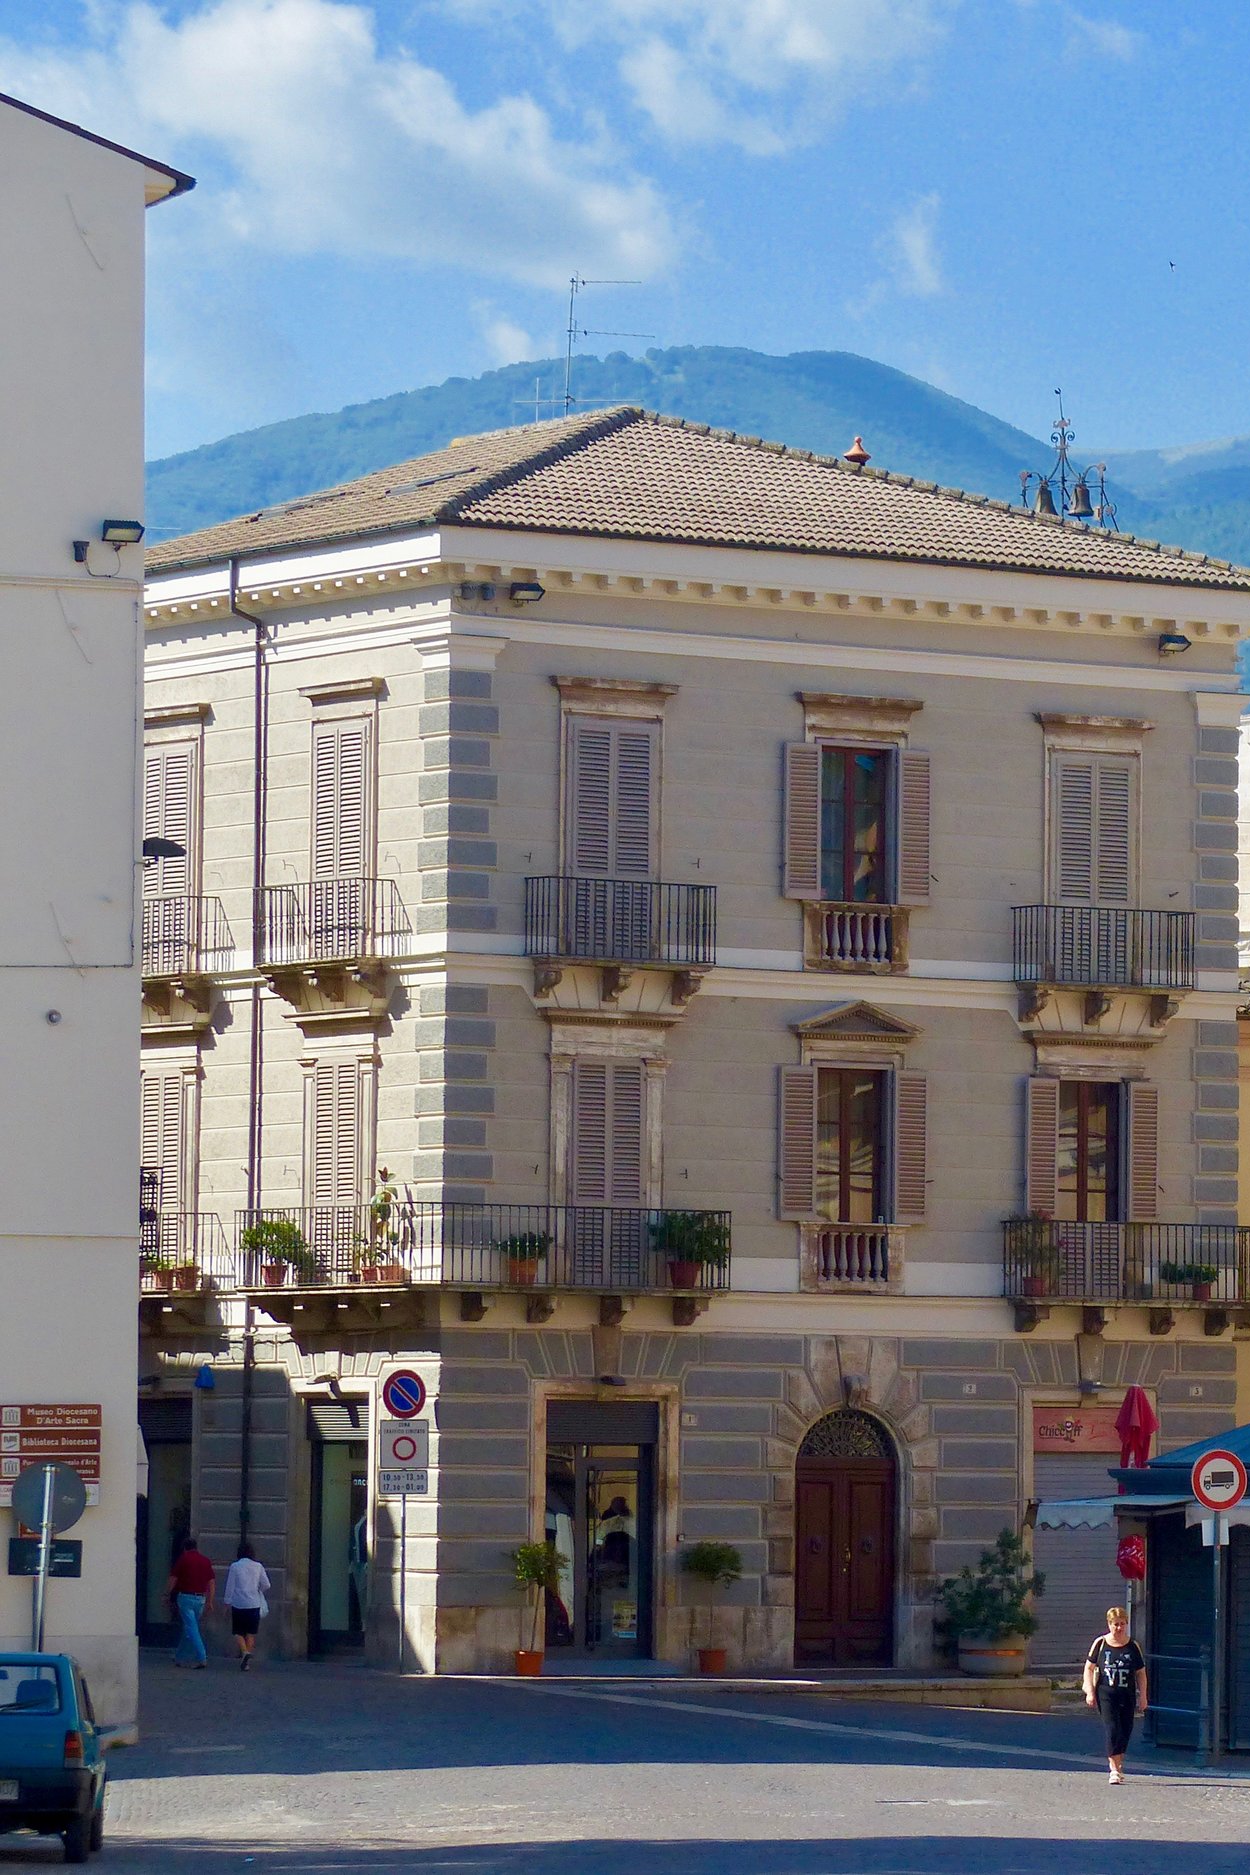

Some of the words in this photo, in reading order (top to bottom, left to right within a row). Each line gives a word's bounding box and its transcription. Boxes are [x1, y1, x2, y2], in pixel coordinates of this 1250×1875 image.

[36, 1416, 63, 1424] D'Arte
[65, 1416, 89, 1424] Sacra
[1038, 1423, 1083, 1437] Chiccff
[22, 1437, 59, 1446] Biblioteca
[61, 1437, 97, 1446] Diocesana
